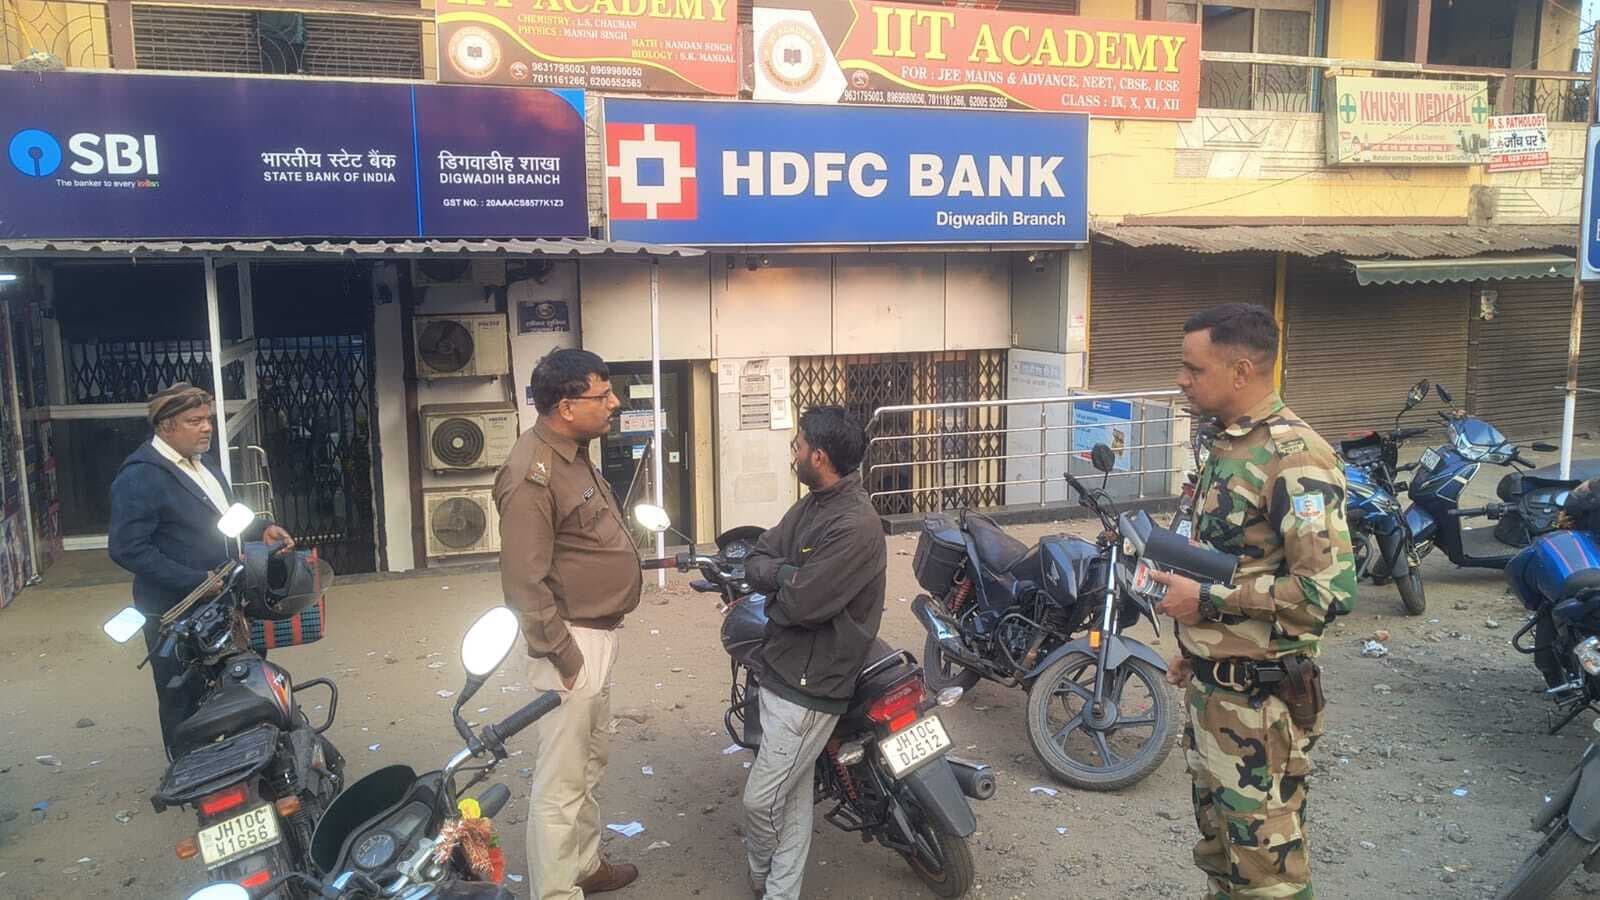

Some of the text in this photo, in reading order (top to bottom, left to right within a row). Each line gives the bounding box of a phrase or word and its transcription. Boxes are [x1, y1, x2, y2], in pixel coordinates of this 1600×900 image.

[518, 14, 570, 26] CHEMISTRY
[595, 18, 638, 30] CHAUHAN
[518, 26, 558, 37] PHYSICS
[564, 28, 598, 40] MANISH
[600, 30, 628, 41] SINGH
[872, 6, 1188, 73] IIT ACADEMY
[632, 39, 657, 49] MATH
[665, 40, 702, 52] NANDAN
[704, 42, 733, 53] SINGH
[631, 49, 673, 61] BIOLOGY
[699, 53, 737, 64] MANDAL
[902, 66, 928, 81] FOR
[937, 69, 961, 82] JEE
[964, 70, 1004, 85] MAINS
[1007, 72, 1017, 85] &
[1020, 73, 1080, 88] ADVANCE,
[1083, 76, 1117, 91] NEET,
[1120, 77, 1151, 92] CBSE,
[1154, 79, 1180, 92] ICSE
[1061, 93, 1101, 107] CLASS
[1111, 95, 1126, 109] IX,
[1129, 96, 1142, 110] X,
[1144, 97, 1160, 111] XI,
[1162, 98, 1180, 111] XII
[1360, 90, 1472, 124] KHUSHI MEDICAL
[1506, 115, 1546, 128] PATHOLOGY
[1525, 135, 1538, 147] घर
[69, 132, 160, 175] SBI
[261, 147, 396, 170] भारतीय स्टेट बैंक
[438, 150, 561, 172] डिगवाडीह शाखा
[263, 171, 396, 183] STATE BANK OF INDIA
[439, 173, 561, 185] DIGWADIH BRANCH
[722, 150, 1065, 198] HDFC BANK
[56, 179, 72, 188] The
[73, 179, 102, 188] banker
[103, 180, 112, 188] to
[113, 180, 135, 189] every
[443, 199, 461, 207] GST
[936, 211, 1066, 229] Digwadih Branch
[896, 720, 936, 752] JH10C
[900, 734, 943, 767] D4512
[215, 809, 266, 842] JH10C
